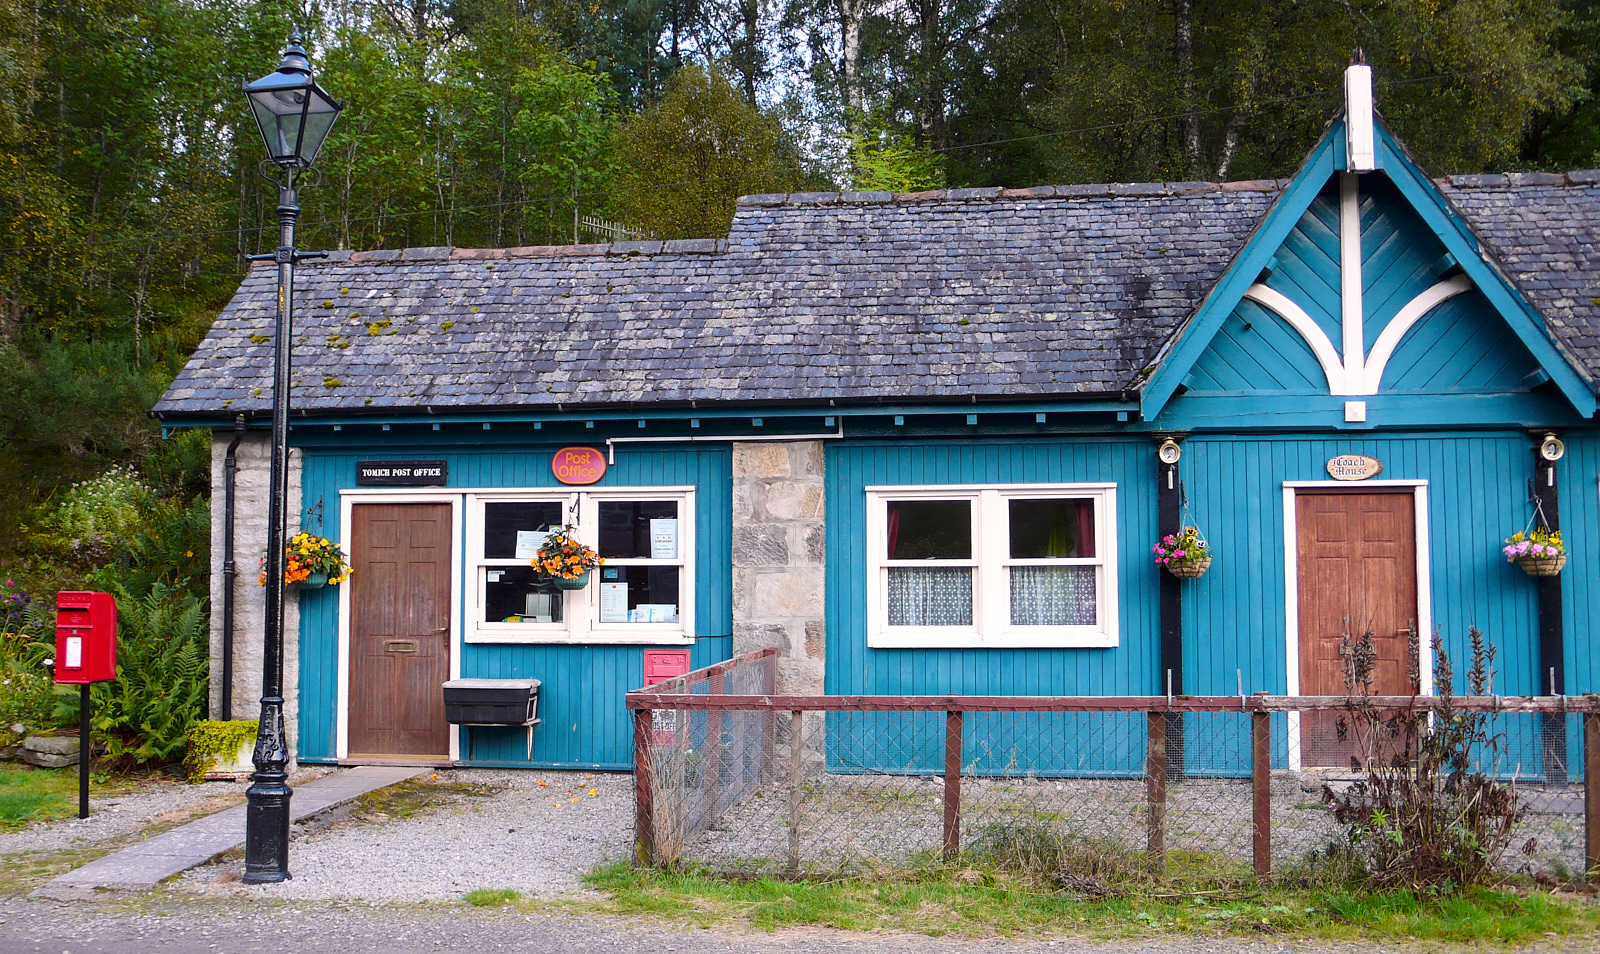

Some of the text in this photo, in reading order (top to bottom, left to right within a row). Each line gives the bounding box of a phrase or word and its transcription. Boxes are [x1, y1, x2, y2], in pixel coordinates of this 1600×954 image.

[566, 452, 591, 464] Post
[1333, 457, 1365, 466] Coach
[362, 468, 441, 477] TOMICH POST OFFICE
[559, 465, 597, 477] Office
[1335, 466, 1367, 476] House
